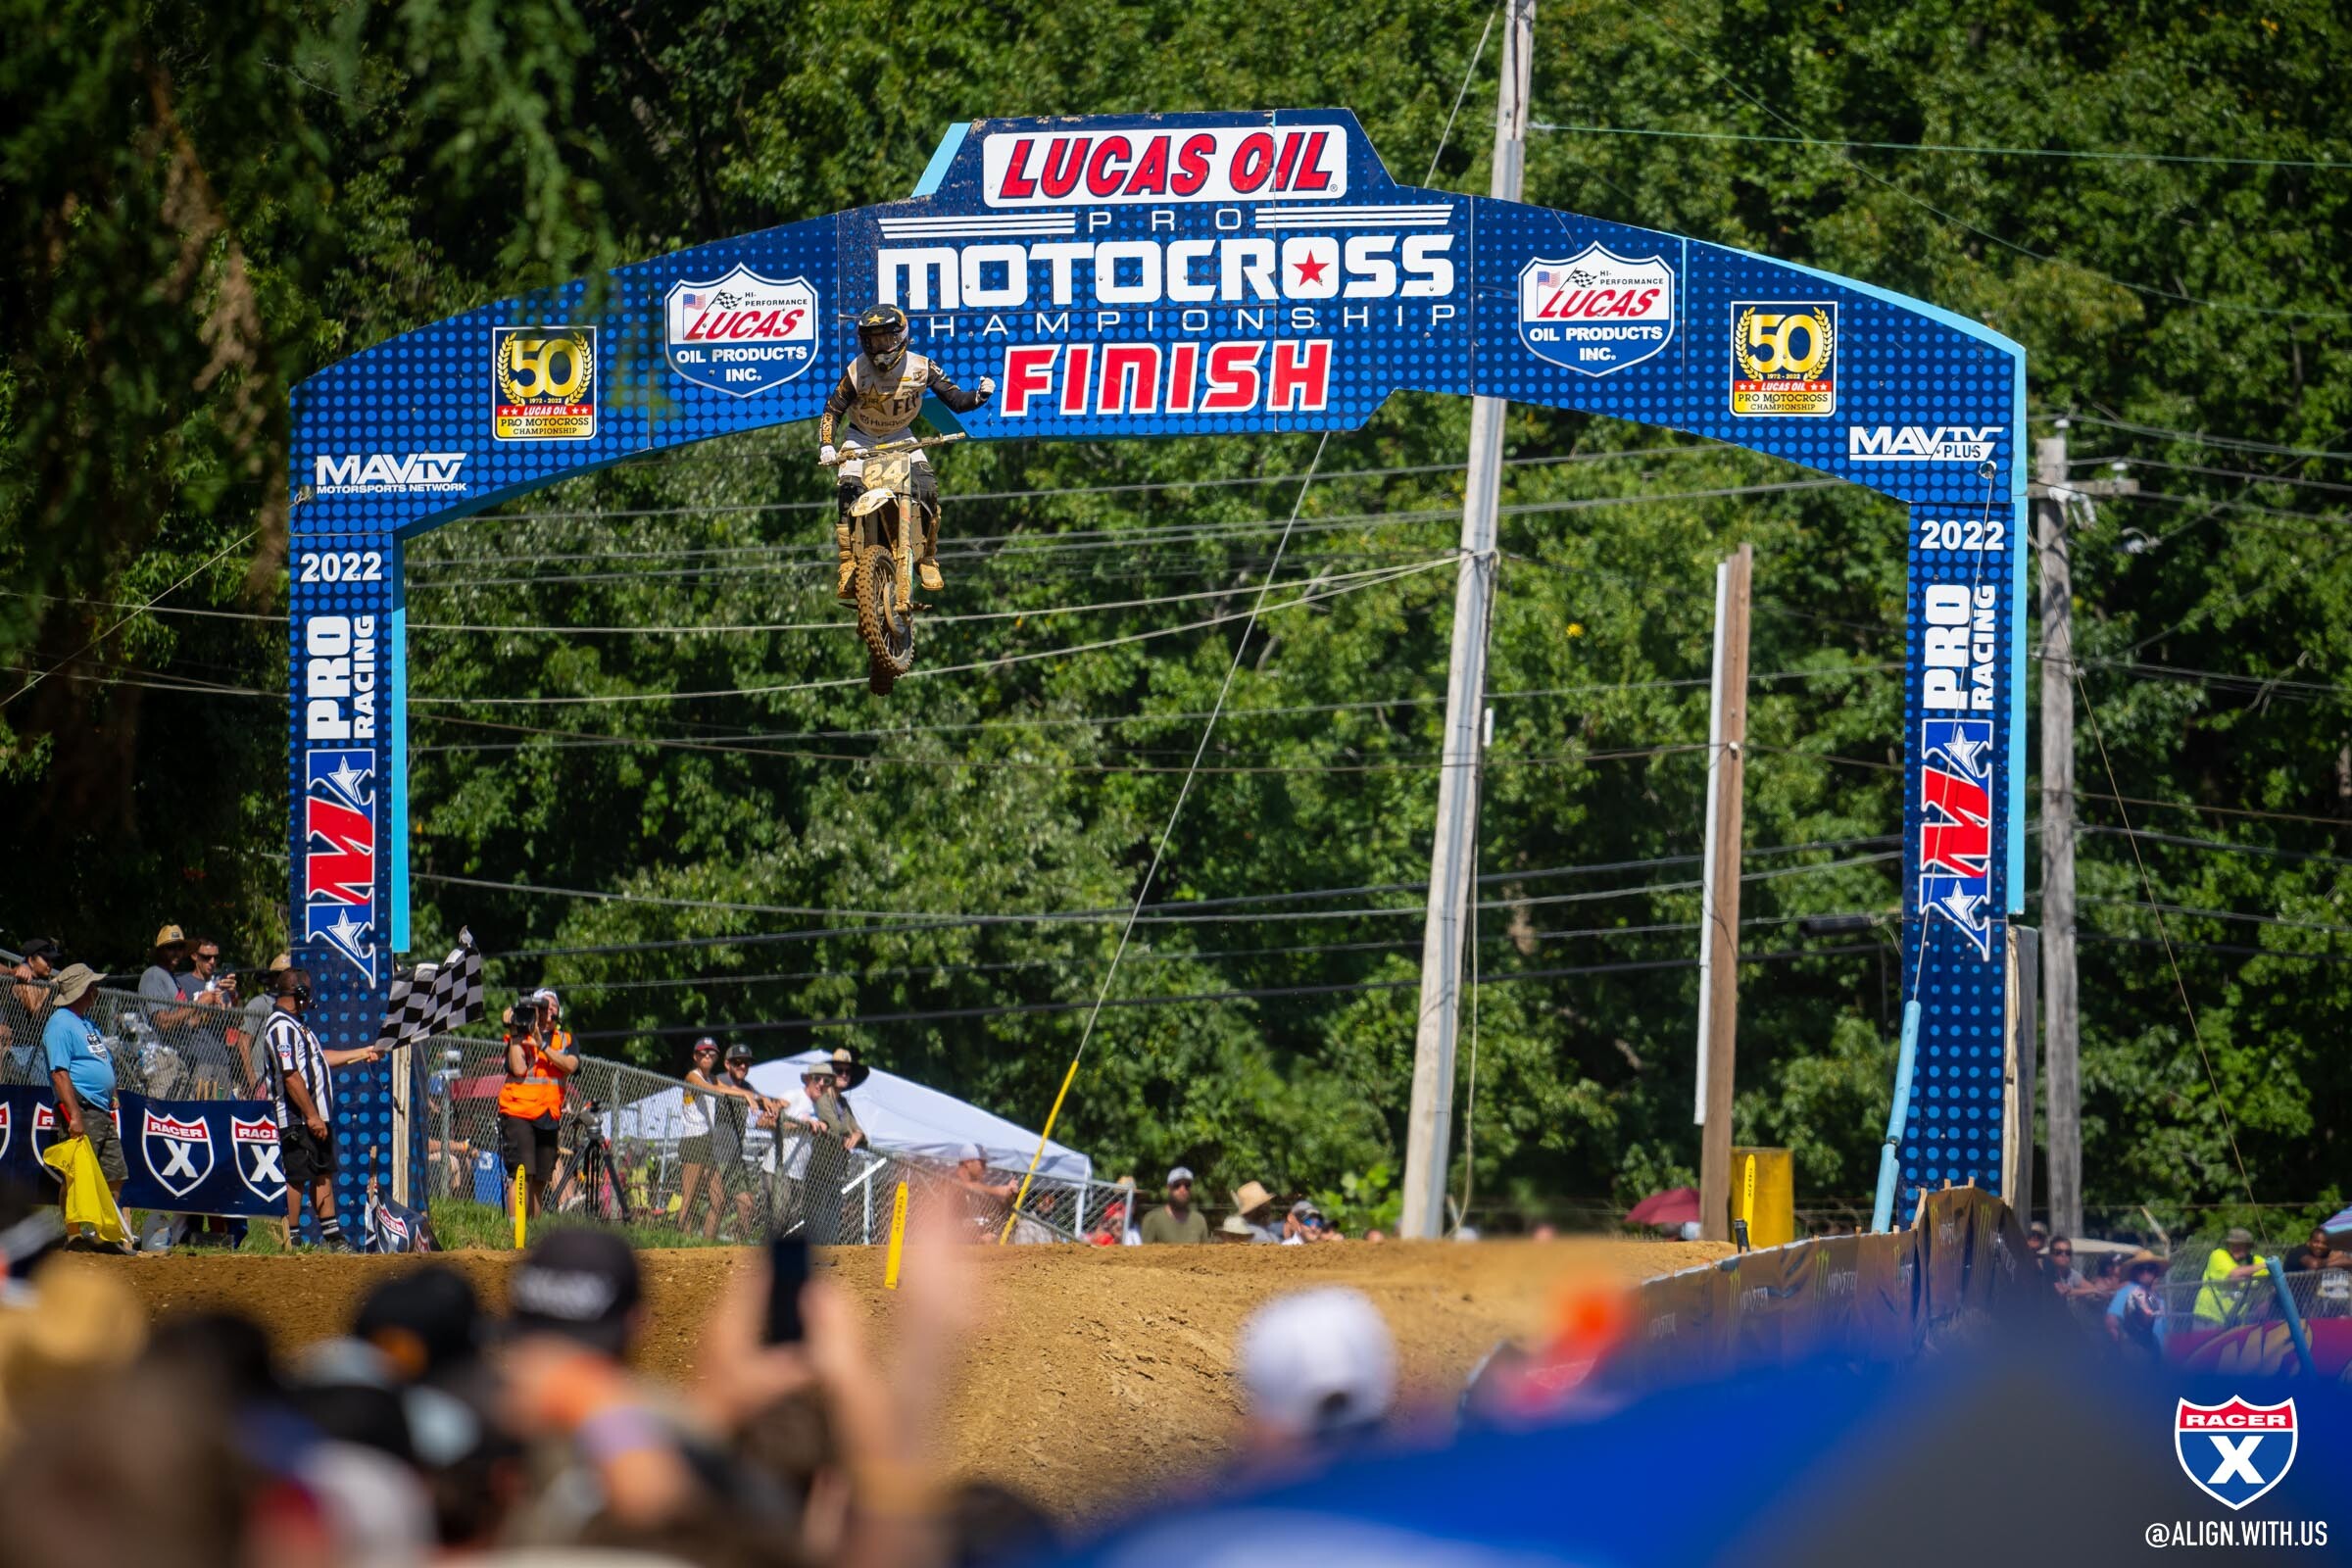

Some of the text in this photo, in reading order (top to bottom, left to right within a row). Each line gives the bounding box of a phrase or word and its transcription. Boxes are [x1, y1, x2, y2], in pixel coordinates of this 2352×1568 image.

[998, 131, 1334, 200] LUCAS OIL
[1089, 208, 1242, 234] PRO
[878, 234, 1454, 311] MOTOCROSS
[745, 298, 808, 307] PERFORMANCE
[1538, 288, 1660, 318] LUCAS
[684, 309, 805, 340] LUCAS
[930, 304, 1456, 339] HAMPIONSHIP
[1529, 326, 1663, 342] OIL PRODUCTS
[676, 346, 808, 364] OIL PRODUCTS
[1579, 347, 1617, 362] INC.
[1746, 314, 1824, 373] 50
[509, 338, 584, 398] 50
[725, 368, 762, 382] INC.
[1001, 339, 1333, 417] FINISH
[1761, 382, 1806, 391] LUCAS OIL
[522, 407, 553, 416] LUCAS
[525, 417, 589, 426] MOTOCROSS
[1849, 426, 2004, 455] MAVTV
[1943, 444, 1982, 459] PLUS
[317, 453, 467, 485] MAVTV
[317, 482, 467, 495] MOTORSPORTS NETWORK
[1920, 519, 2004, 551] 2022
[300, 552, 382, 582] 2022
[1923, 584, 1970, 710] PRO
[1972, 584, 1996, 710] RACING
[307, 615, 351, 740] PRO
[354, 615, 375, 740] RACING
[151, 1121, 203, 1139] RACER
[162, 1138, 199, 1178] X
[249, 1145, 286, 1183] X
